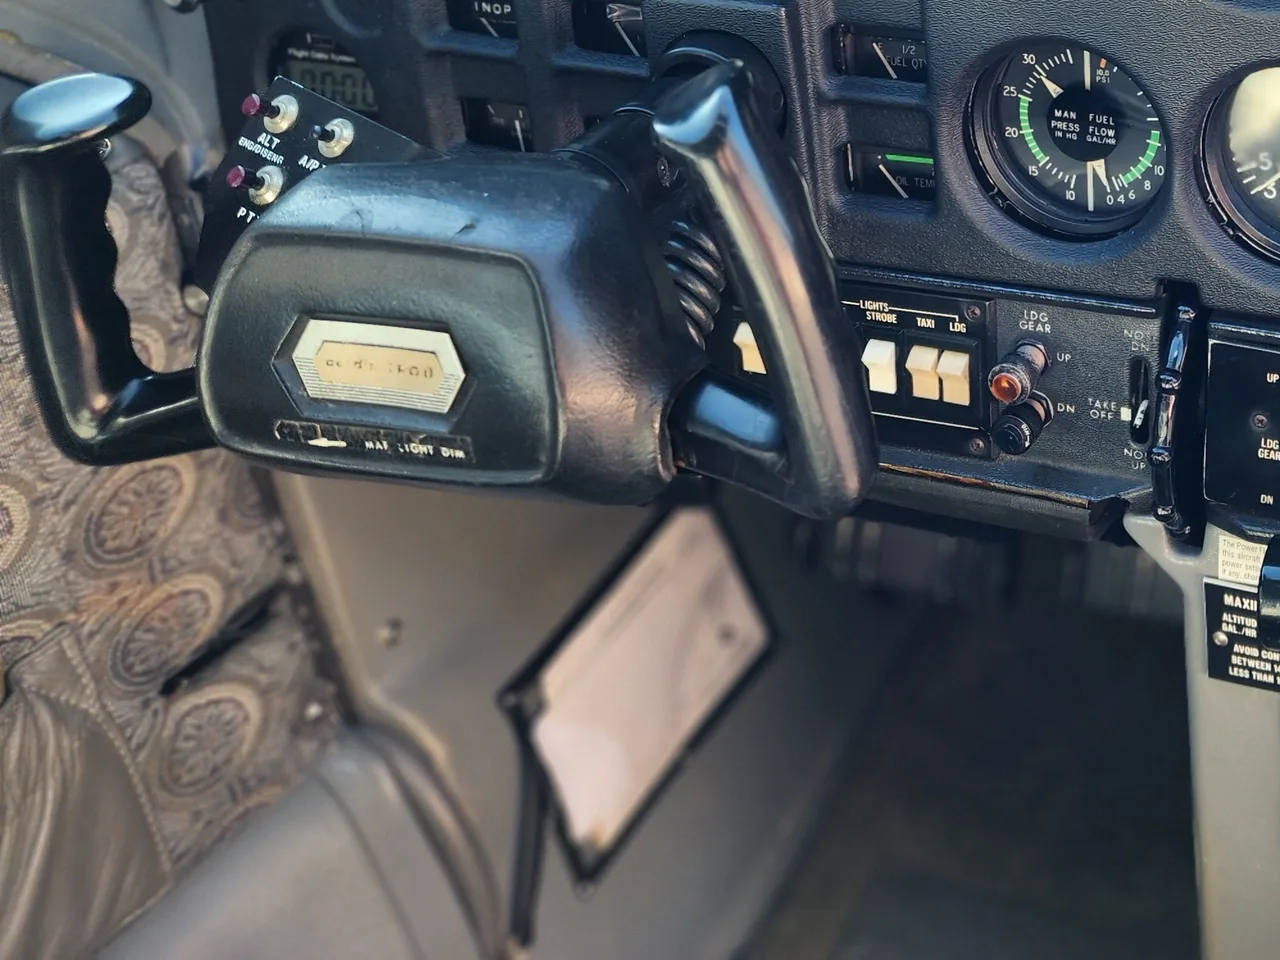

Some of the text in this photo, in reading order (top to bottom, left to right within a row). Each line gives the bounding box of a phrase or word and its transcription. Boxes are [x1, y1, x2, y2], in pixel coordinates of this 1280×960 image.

[474, 1, 512, 15] INOP
[1022, 54, 1036, 65] 30
[1003, 87, 1017, 96] 25
[1054, 109, 1077, 120] MAN
[1089, 114, 1115, 125] FUEL
[1005, 127, 1018, 137] 20
[1051, 121, 1080, 132] PRESS
[1089, 126, 1116, 137] FLOW
[256, 131, 281, 150] ALT
[1086, 135, 1116, 145] GAL/HR
[238, 135, 284, 164] ENG/DISENG
[860, 300, 889, 312] LIGHTS
[866, 311, 897, 324] STROBE
[1023, 310, 1048, 323] LDG
[916, 317, 935, 329] TAXI
[949, 321, 966, 333] LDG
[1019, 320, 1051, 334] GEAR
[1056, 352, 1072, 363] UP
[1267, 373, 1280, 384] UP
[1057, 404, 1075, 414] DN
[1088, 398, 1117, 412] TAKE
[1090, 409, 1115, 422] OFF
[1261, 437, 1279, 451] LDG
[1260, 494, 1274, 505] DN
[1233, 644, 1259, 657] AVOID
[1231, 655, 1272, 672] BETWEEN
[1229, 666, 1250, 679] LESS
[1252, 671, 1274, 685] THAN
